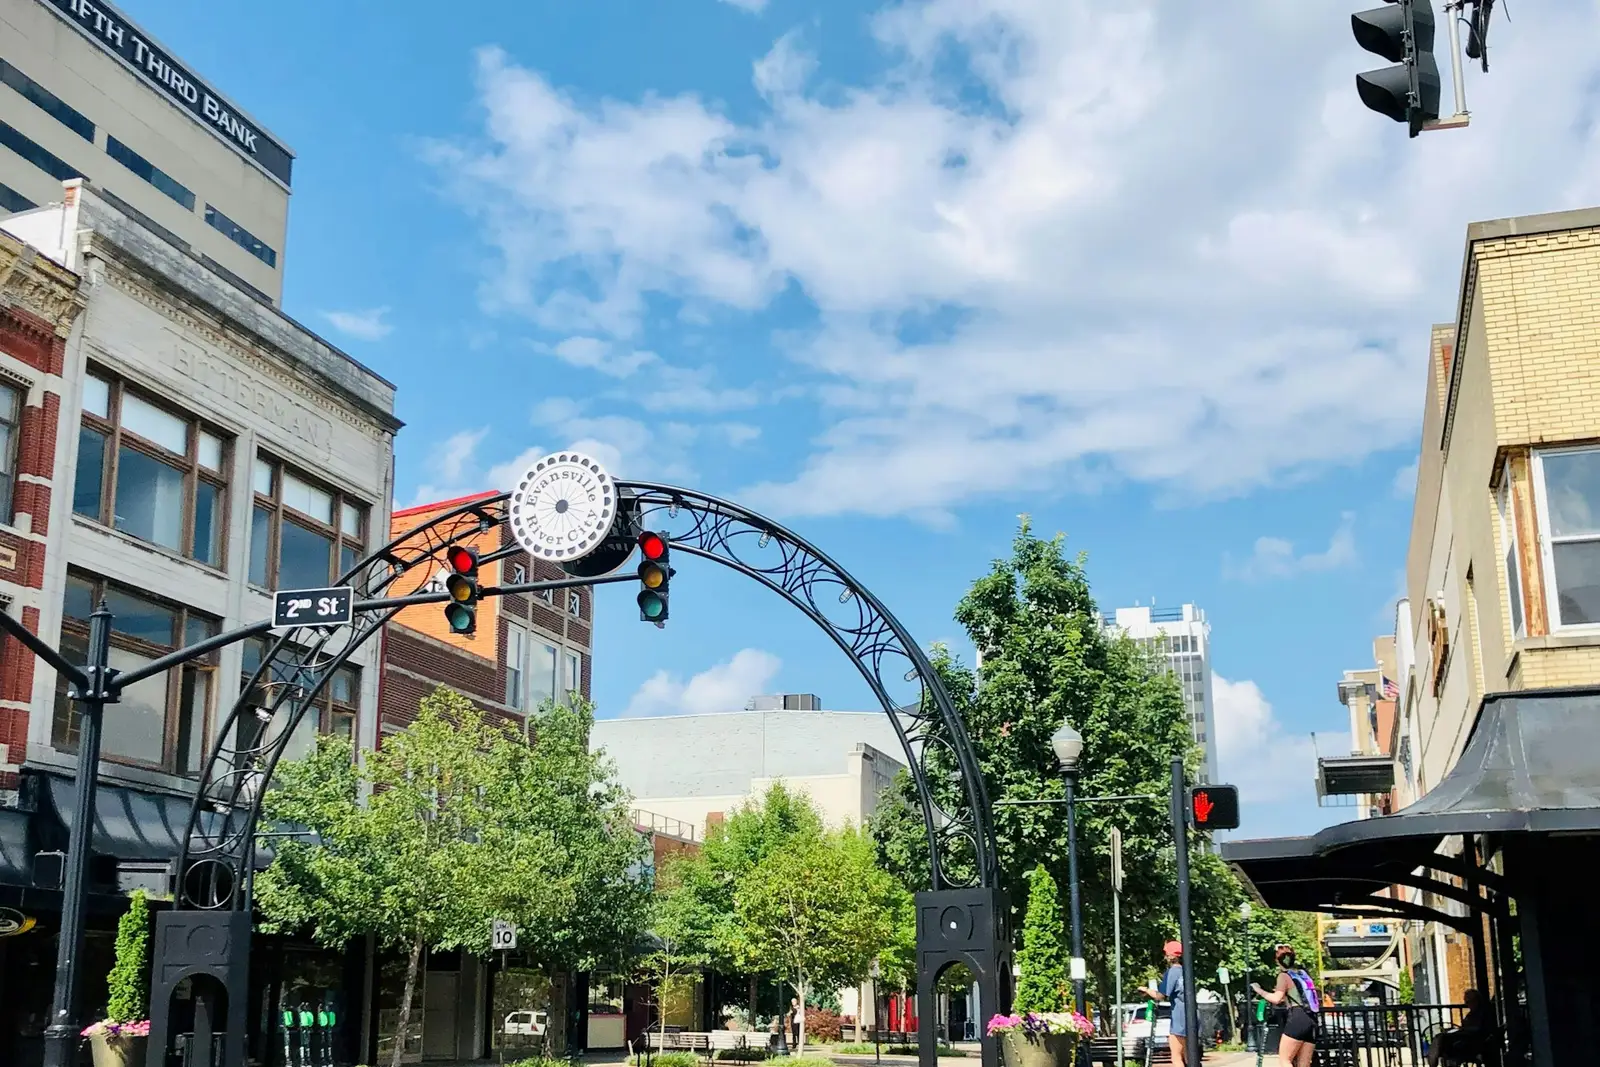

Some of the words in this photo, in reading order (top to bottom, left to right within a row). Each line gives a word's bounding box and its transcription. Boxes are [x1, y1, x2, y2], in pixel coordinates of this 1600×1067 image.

[131, 35, 198, 104] THIRD
[203, 93, 258, 153] BANK
[525, 470, 597, 508] Evansville
[526, 513, 564, 545] River
[567, 509, 598, 542] City
[316, 596, 339, 616] St
[496, 931, 512, 944] 10
